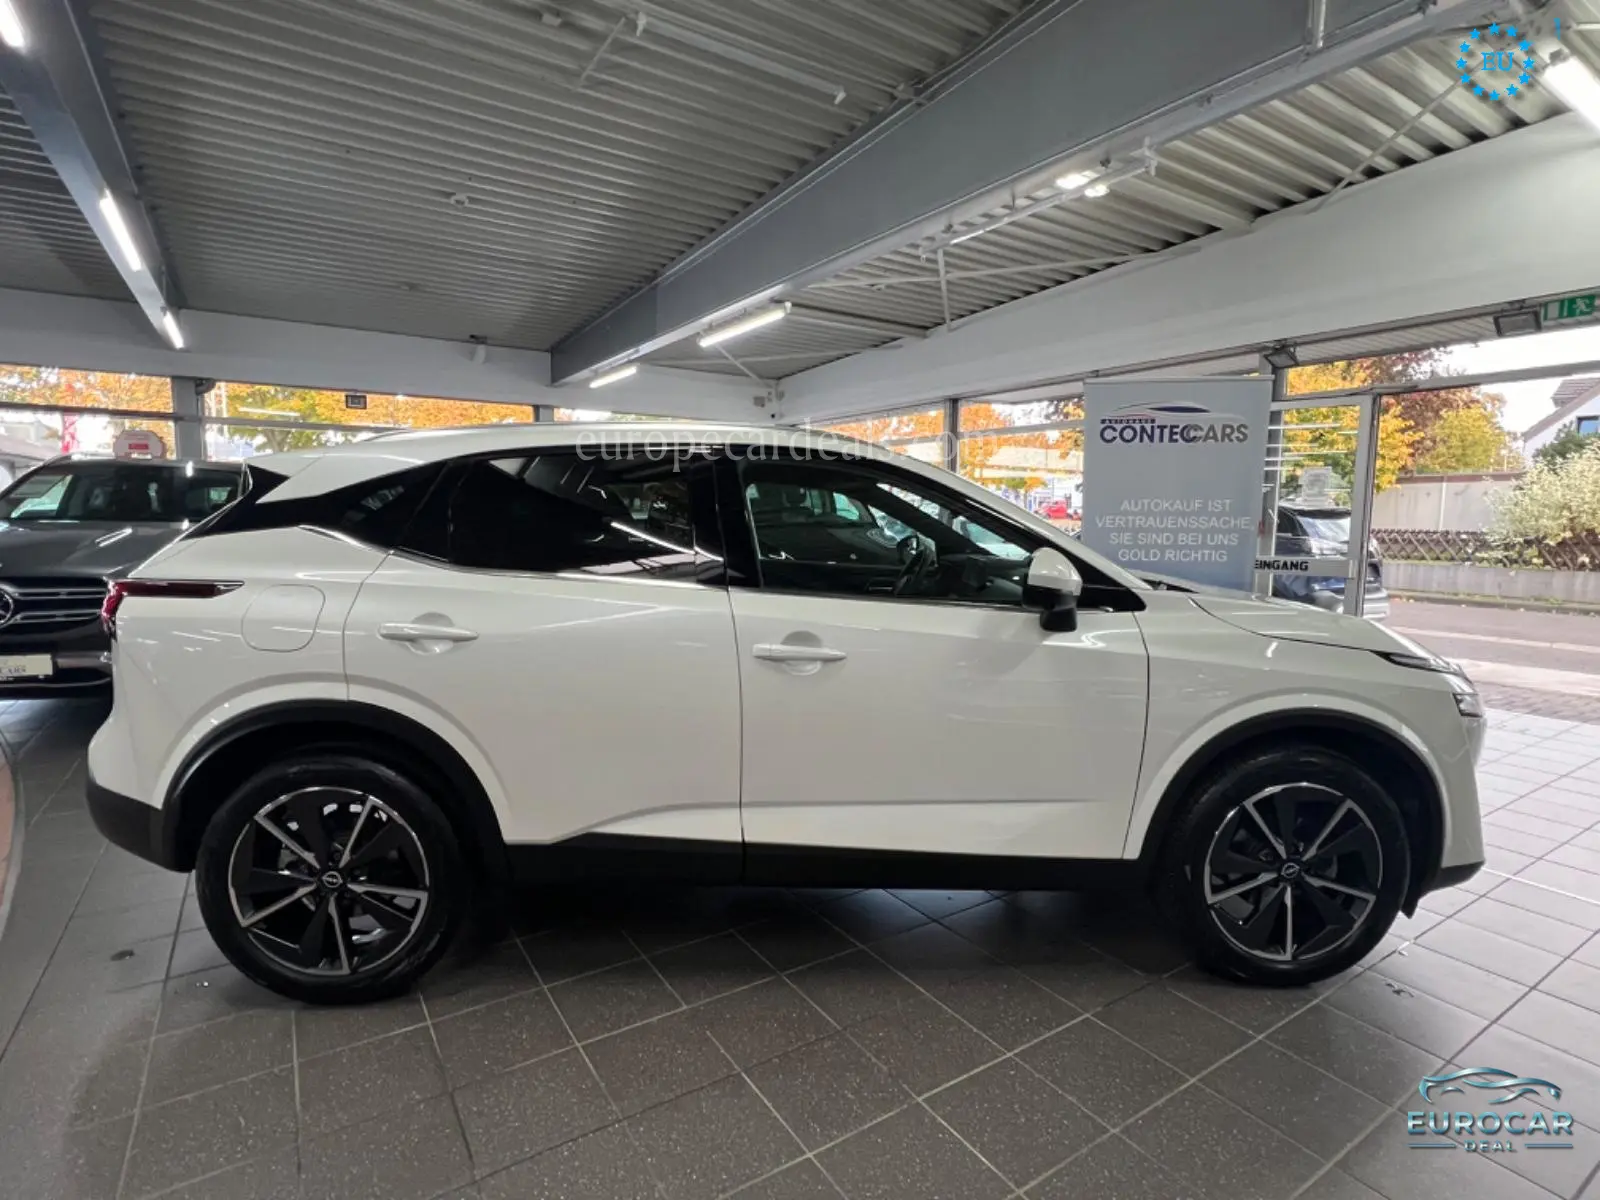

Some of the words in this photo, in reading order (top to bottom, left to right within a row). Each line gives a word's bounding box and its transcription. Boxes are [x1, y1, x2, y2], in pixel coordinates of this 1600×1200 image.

[1120, 499, 1203, 512] AUTOKAUF
[1208, 499, 1231, 512] IST
[1109, 532, 1133, 545] SIE
[1137, 532, 1174, 545] SIND
[1178, 533, 1202, 545] BEI
[1206, 533, 1239, 545] UNS
[1118, 549, 1160, 561] GOLD
[1164, 549, 1228, 562] RICHTIG
